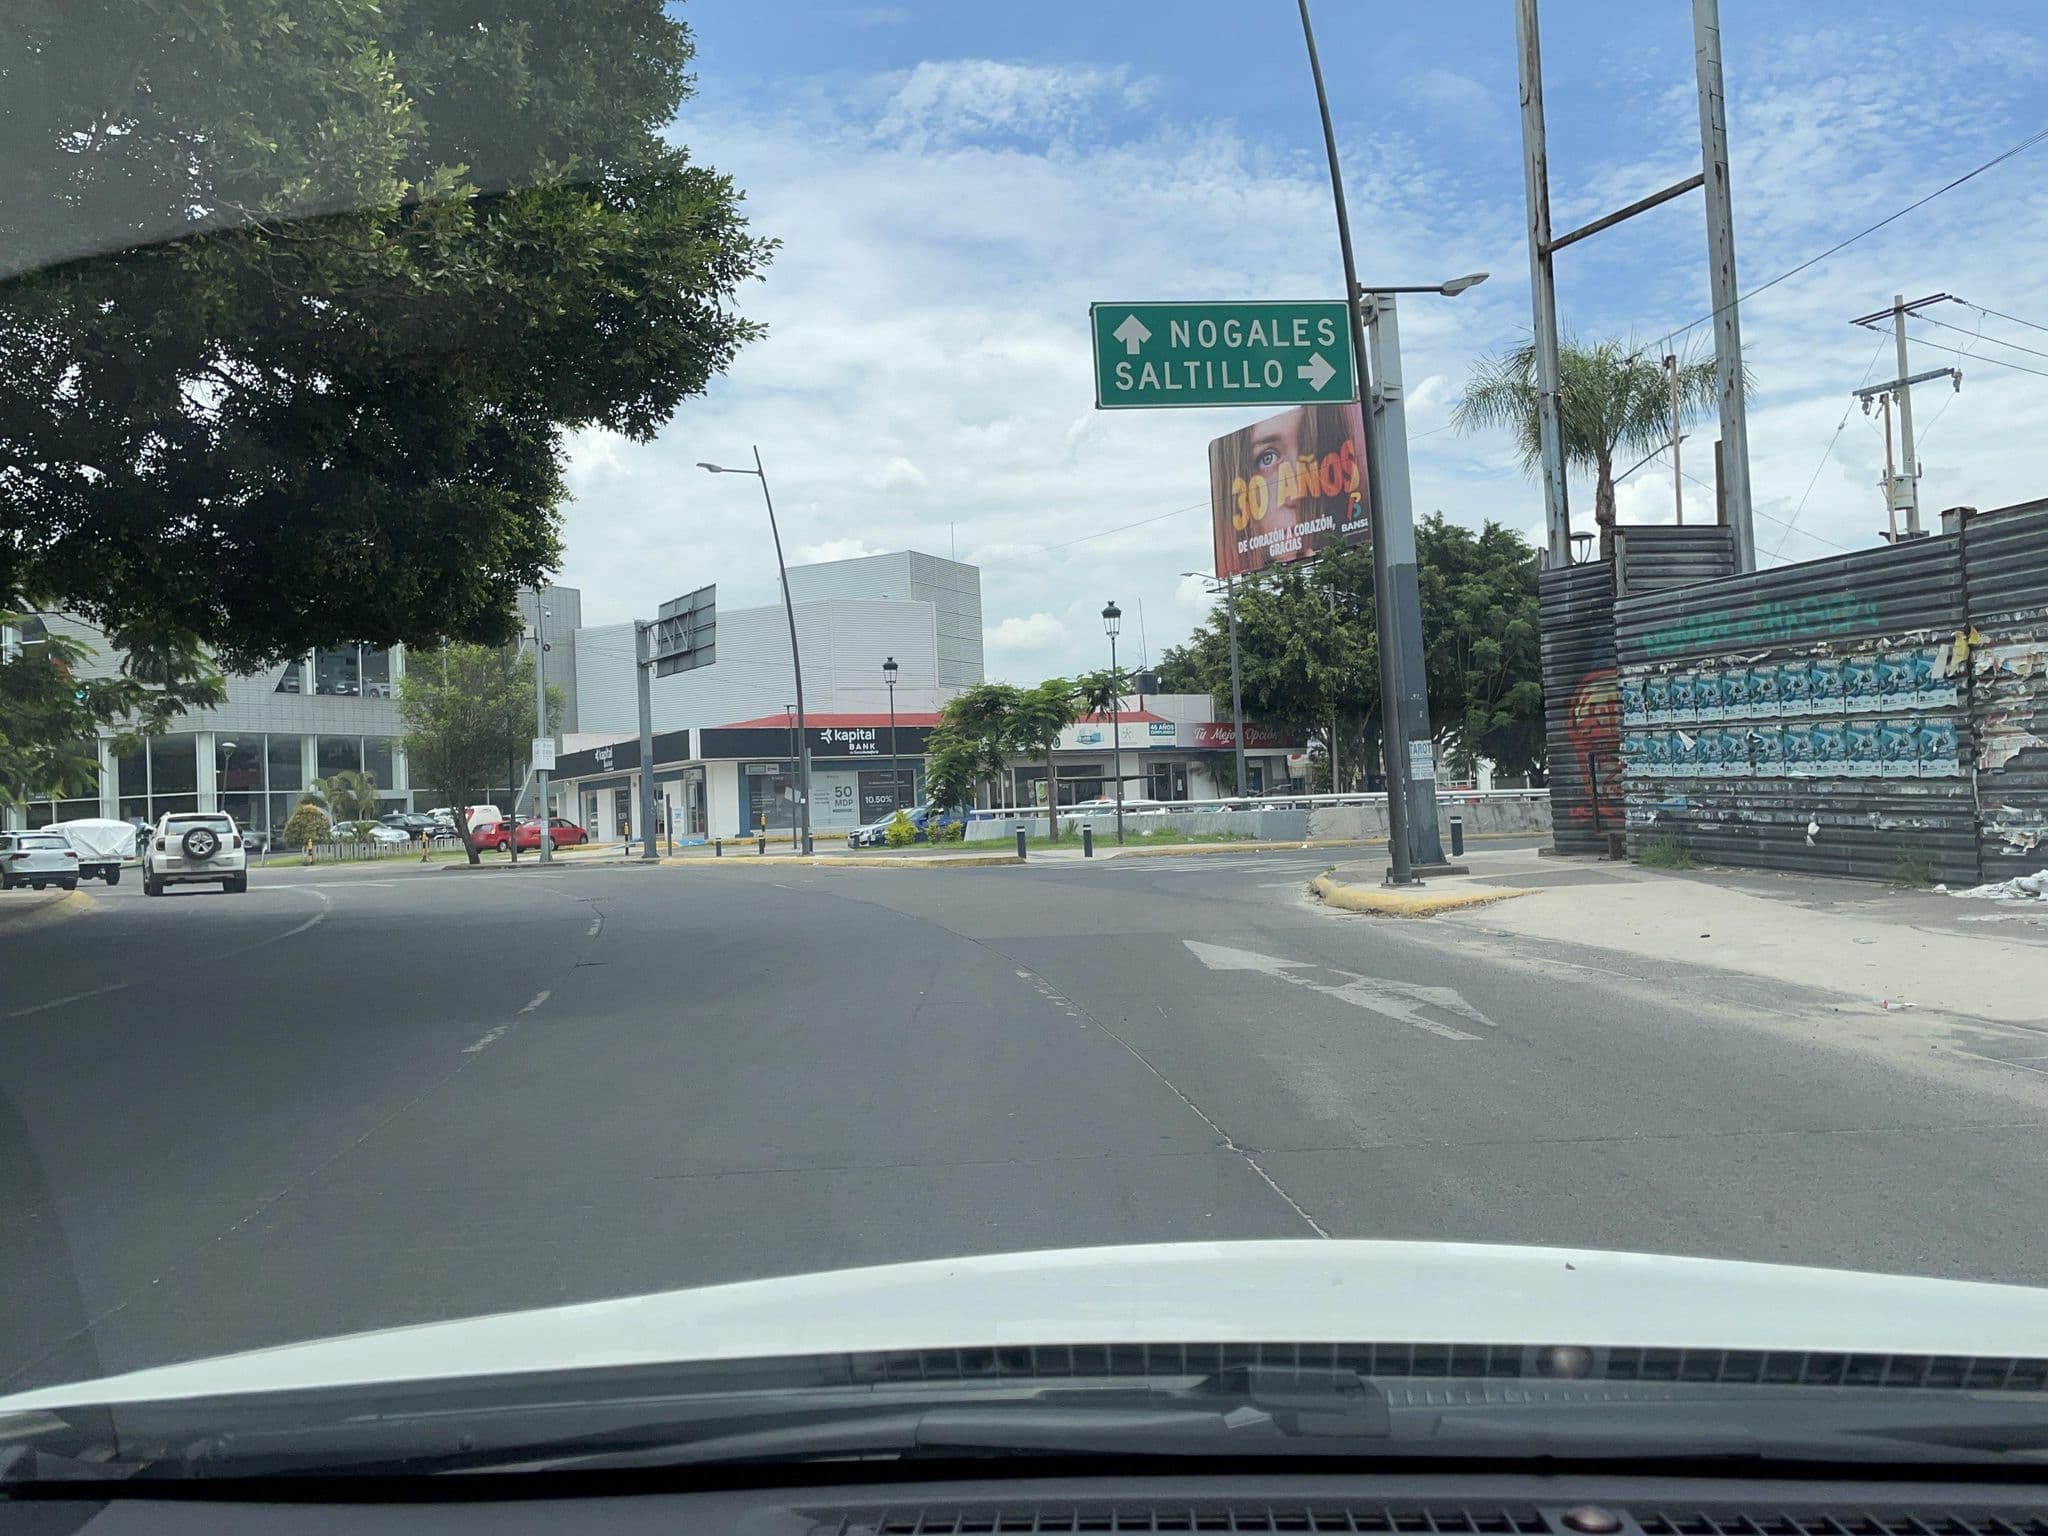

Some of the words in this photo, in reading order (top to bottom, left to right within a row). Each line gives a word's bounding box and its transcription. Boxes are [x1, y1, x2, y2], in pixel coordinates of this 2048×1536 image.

[1170, 318, 1336, 348] NOGALES
[1115, 360, 1283, 390] SALTILLO
[1232, 474, 1269, 531] 30
[1277, 439, 1360, 507] AÑOS
[1238, 541, 1248, 554] DE
[1249, 528, 1285, 549] CORAZÓN
[1286, 528, 1293, 539] A
[1294, 514, 1336, 536] CORAZÓN,
[1269, 537, 1303, 557] GRACIAS
[834, 728, 875, 743] kapital
[1194, 727, 1207, 740] Tu
[1210, 728, 1235, 745] Mejo
[849, 743, 876, 751] BANK
[1409, 742, 1432, 756] TAROT
[834, 786, 852, 798] 50
[865, 795, 893, 804] 10.50%
[834, 799, 854, 807] MDP
